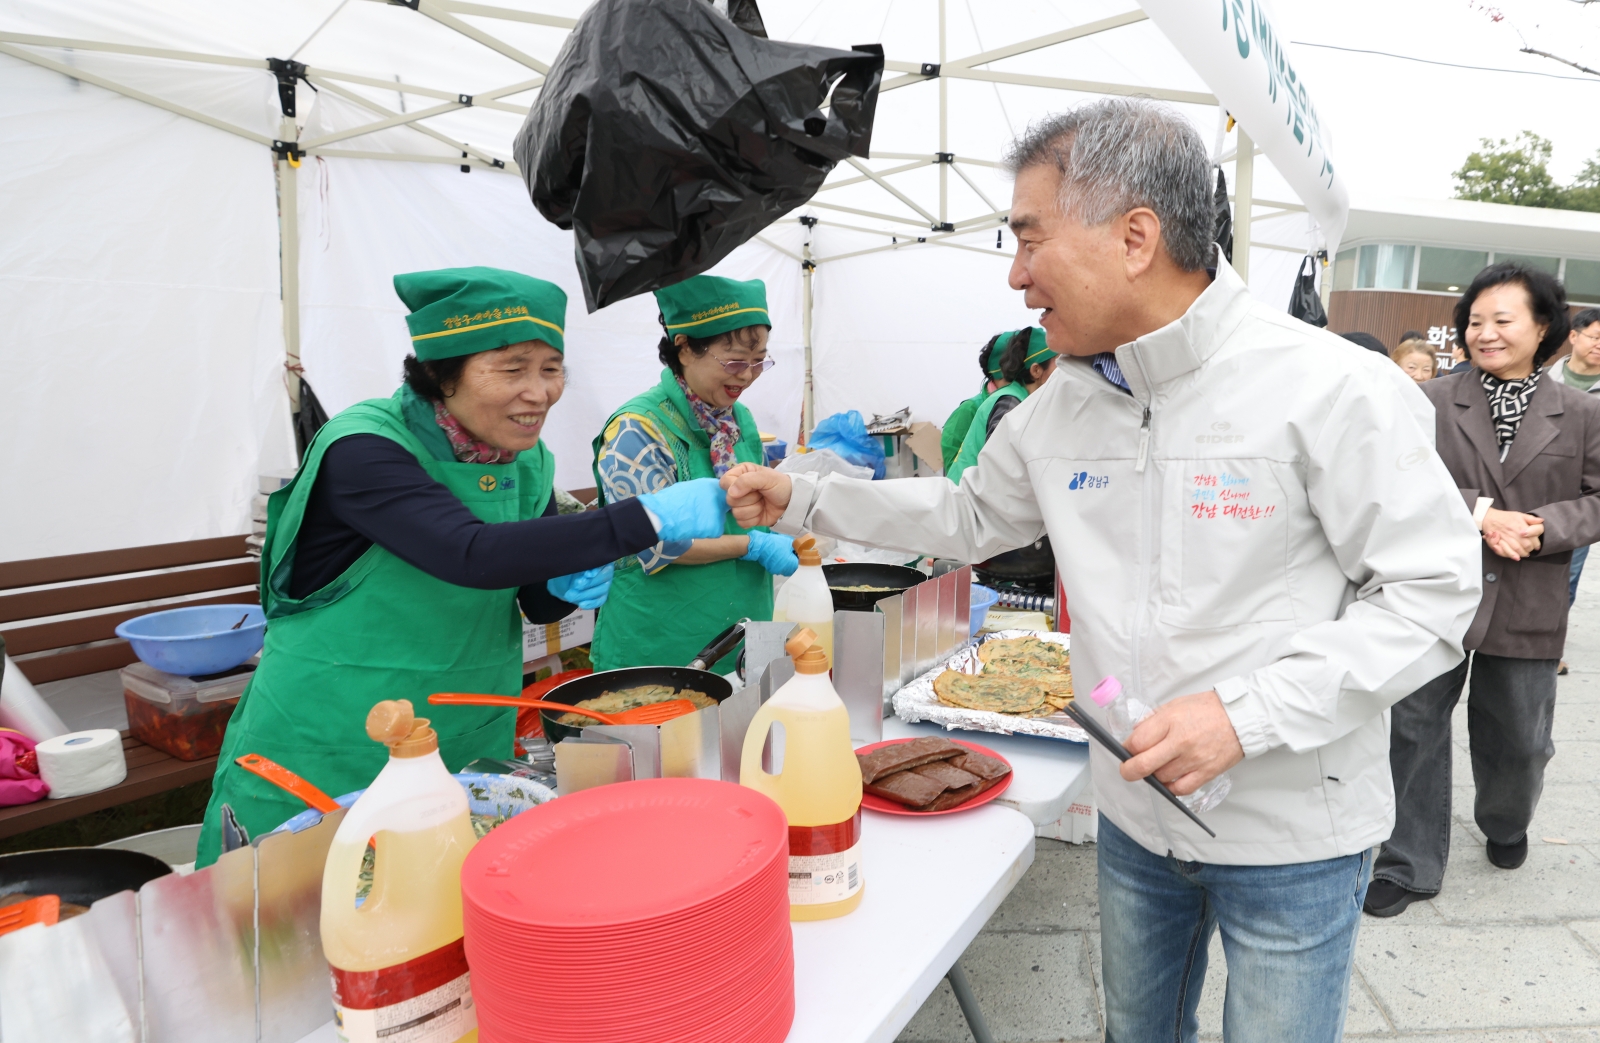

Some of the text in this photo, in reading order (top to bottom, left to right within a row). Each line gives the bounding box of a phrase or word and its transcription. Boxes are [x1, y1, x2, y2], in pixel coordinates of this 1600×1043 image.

[1194, 434, 1245, 444] EIDER
[1087, 475, 1109, 489] 강남구
[1193, 473, 1218, 487] 강남을
[1191, 488, 1250, 501] 구민을 신나게!
[1191, 501, 1276, 520] 강남 대전환!!
